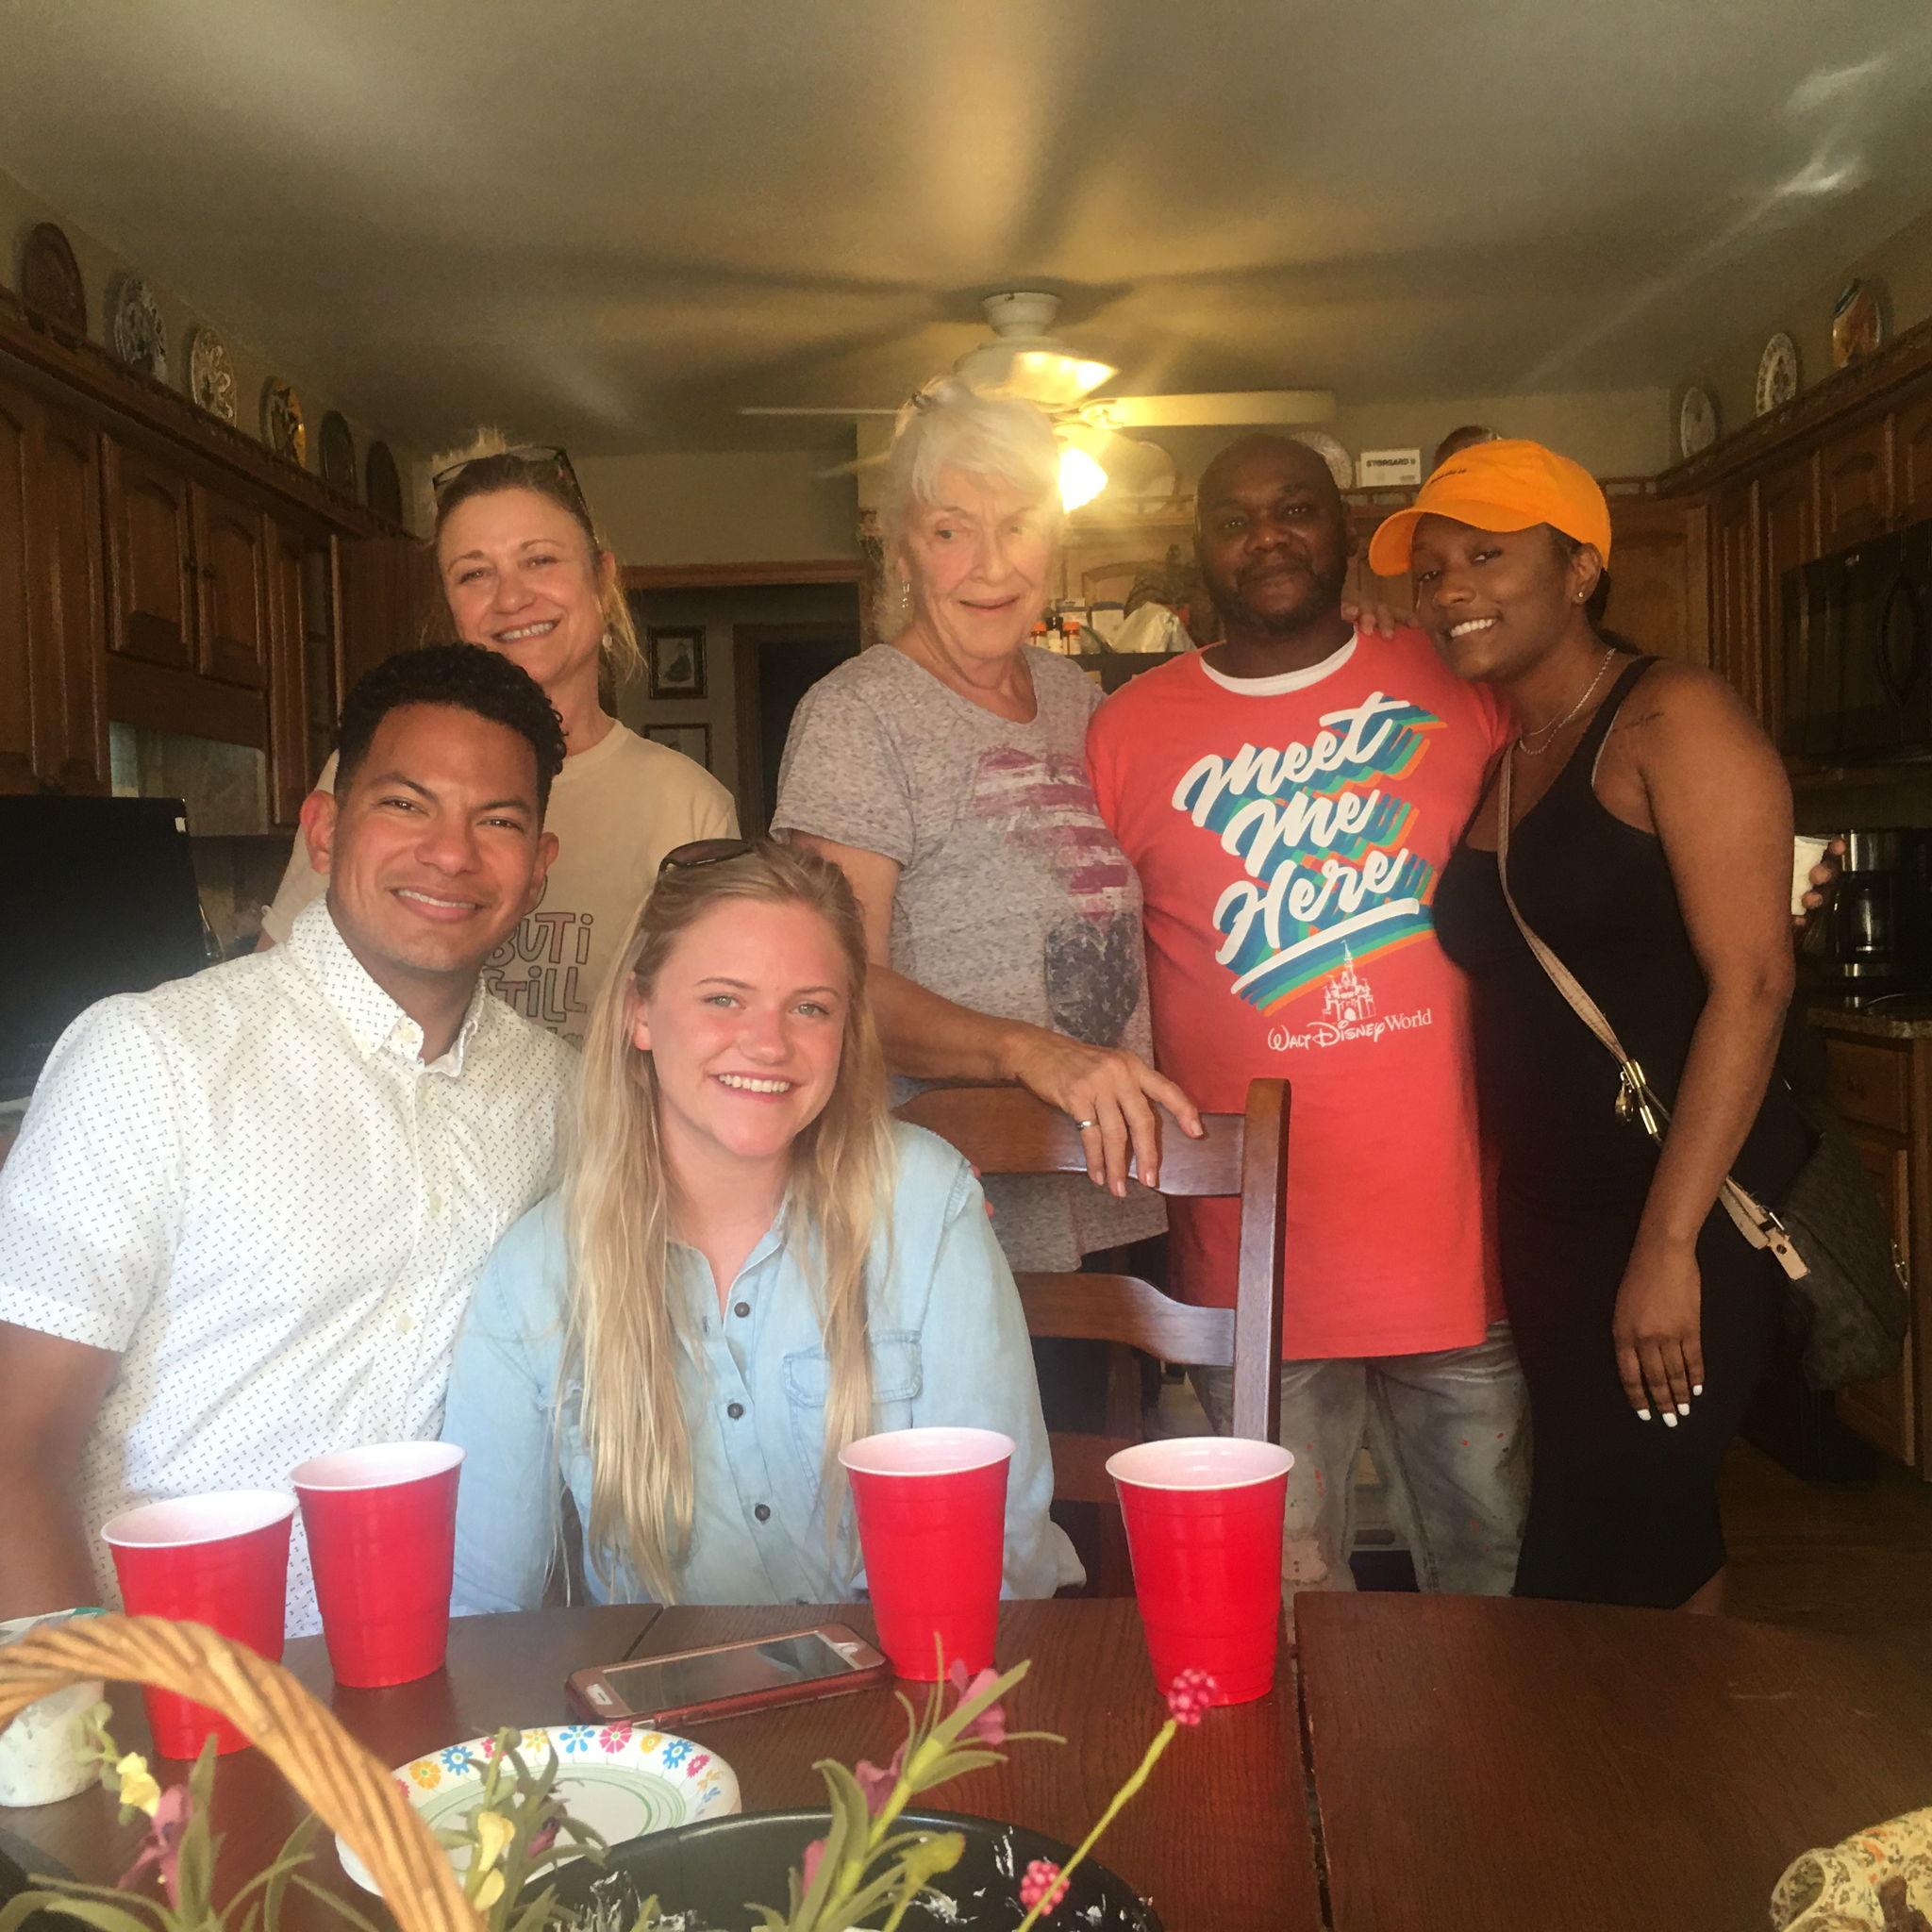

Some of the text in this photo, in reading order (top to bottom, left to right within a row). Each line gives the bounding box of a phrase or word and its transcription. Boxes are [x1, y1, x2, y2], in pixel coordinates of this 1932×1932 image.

[1172, 691, 1410, 827] Meet
[1221, 789, 1380, 876] Me
[1212, 848, 1409, 964] Here
[1384, 1008, 1432, 1031] World
